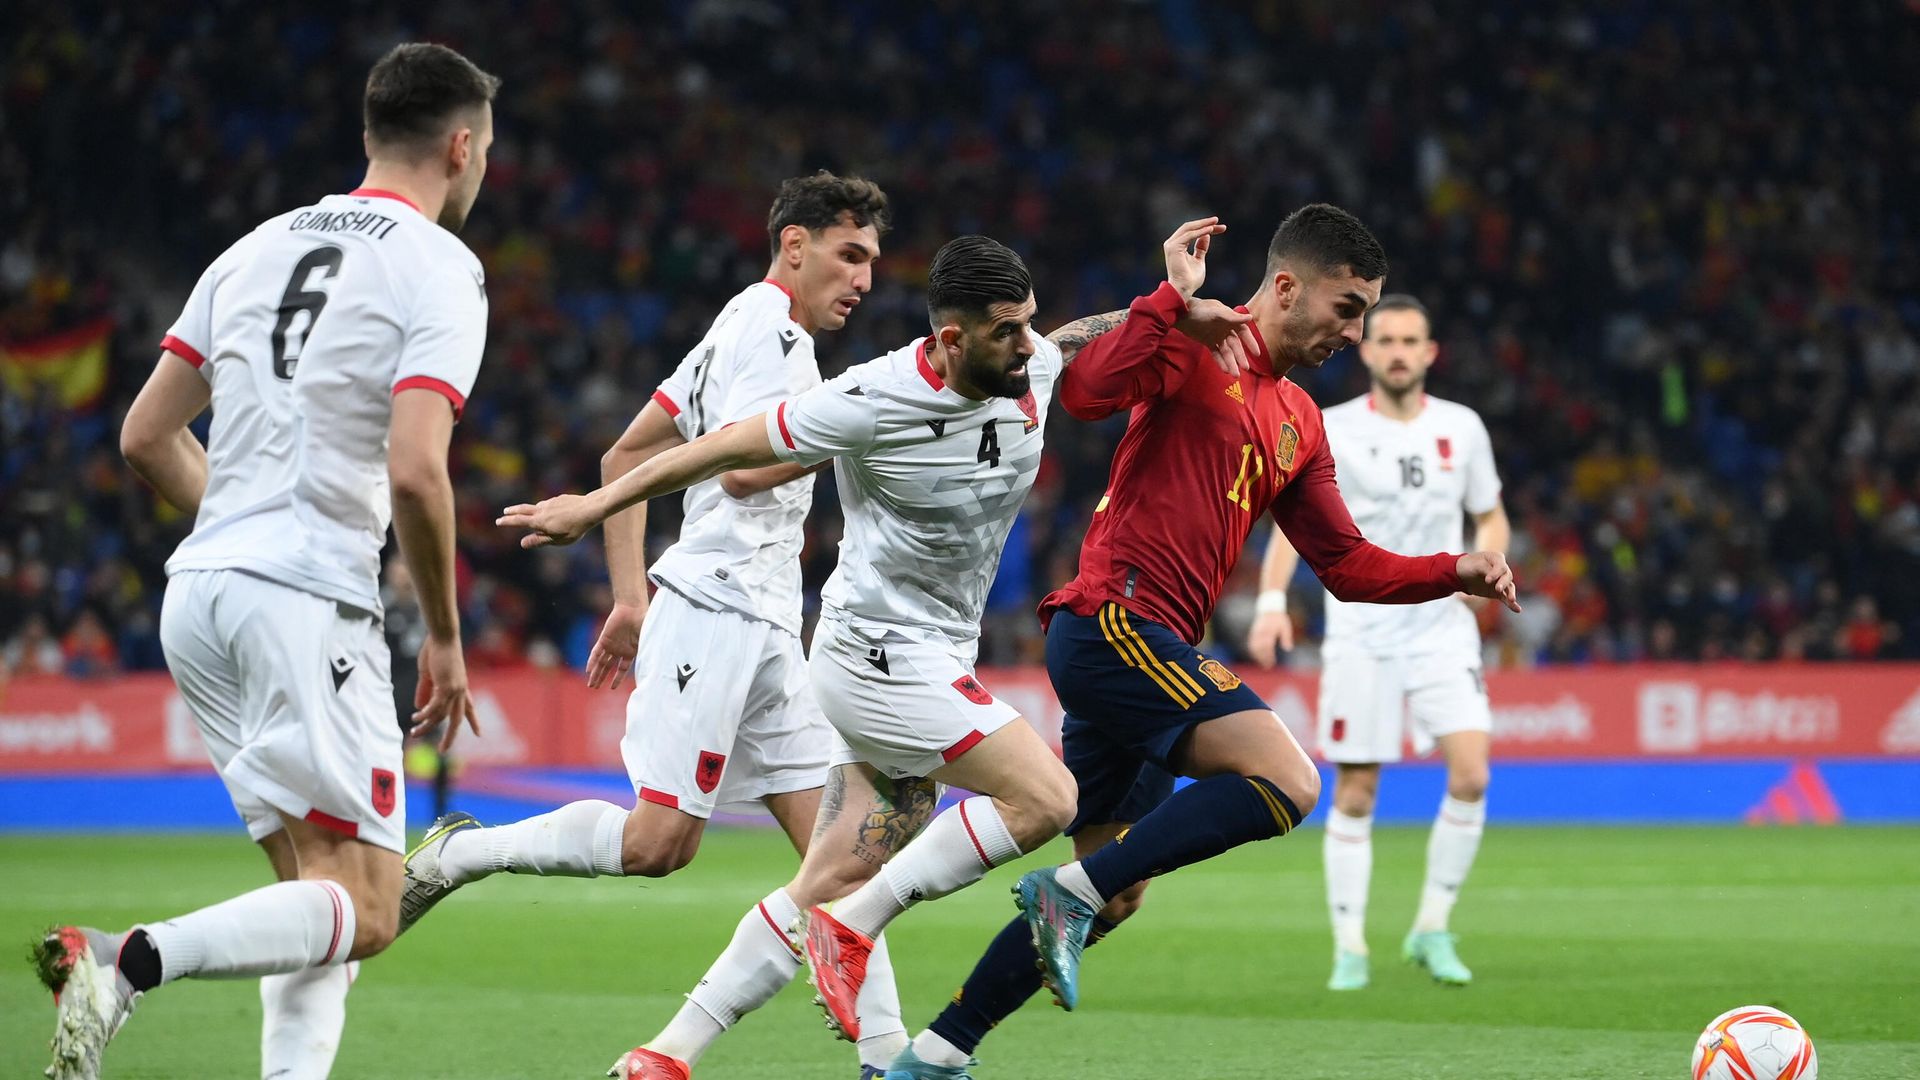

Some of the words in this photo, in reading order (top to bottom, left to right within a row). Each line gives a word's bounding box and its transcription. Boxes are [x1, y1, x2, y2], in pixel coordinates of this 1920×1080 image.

[289, 211, 399, 240] GJIMSHITI
[272, 245, 344, 381] 6
[977, 417, 1002, 469] 4
[1226, 443, 1264, 512] 11
[1398, 455, 1425, 488] 16
